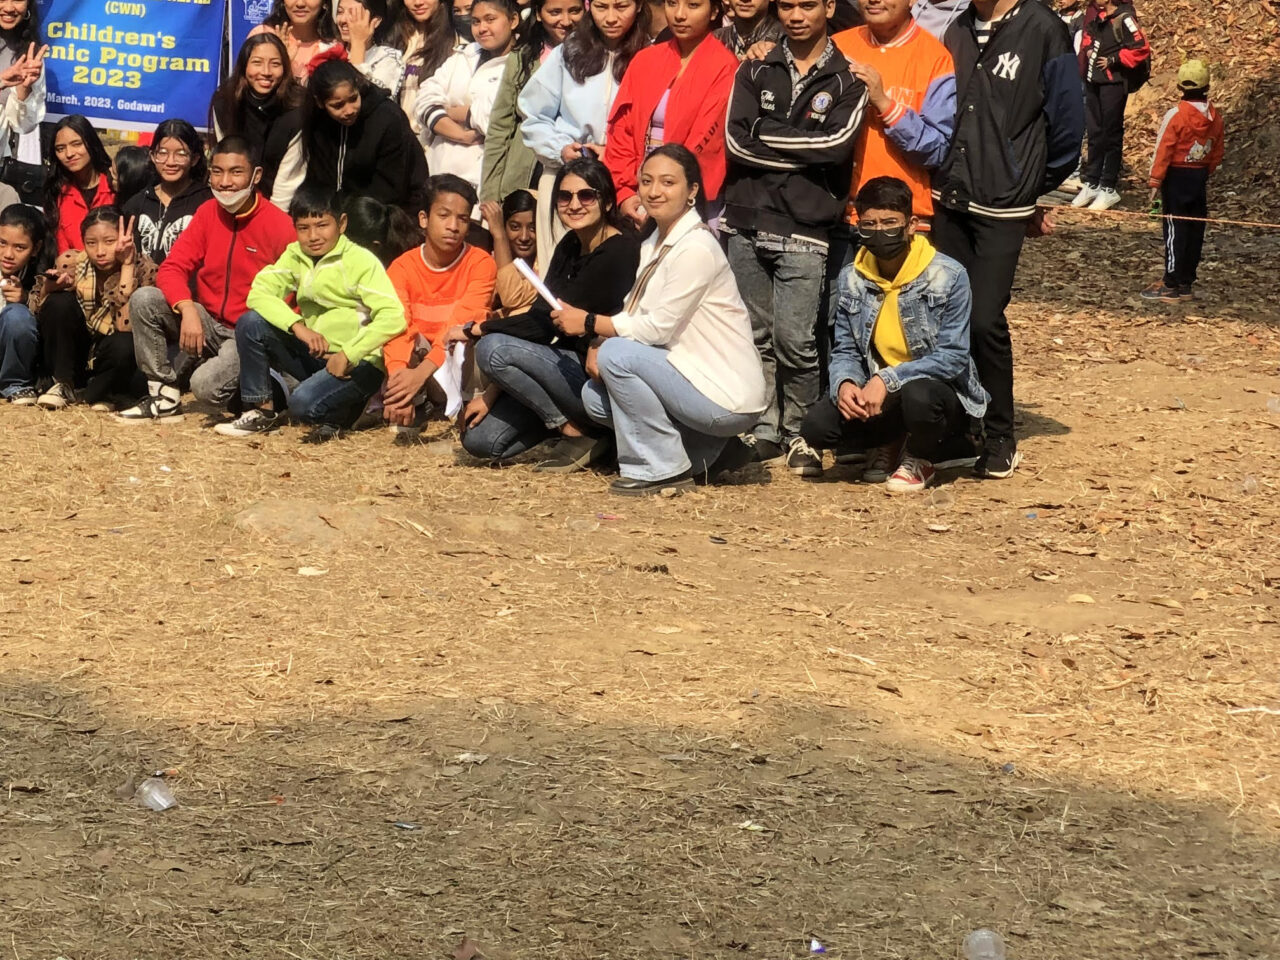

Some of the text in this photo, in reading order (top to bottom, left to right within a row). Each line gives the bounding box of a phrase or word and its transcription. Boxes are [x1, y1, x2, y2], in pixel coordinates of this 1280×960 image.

[105, 1, 146, 17] (CWN)
[47, 21, 176, 49] Children's
[99, 46, 210, 72] Program
[991, 51, 1021, 81] NY
[73, 66, 141, 89] 2023
